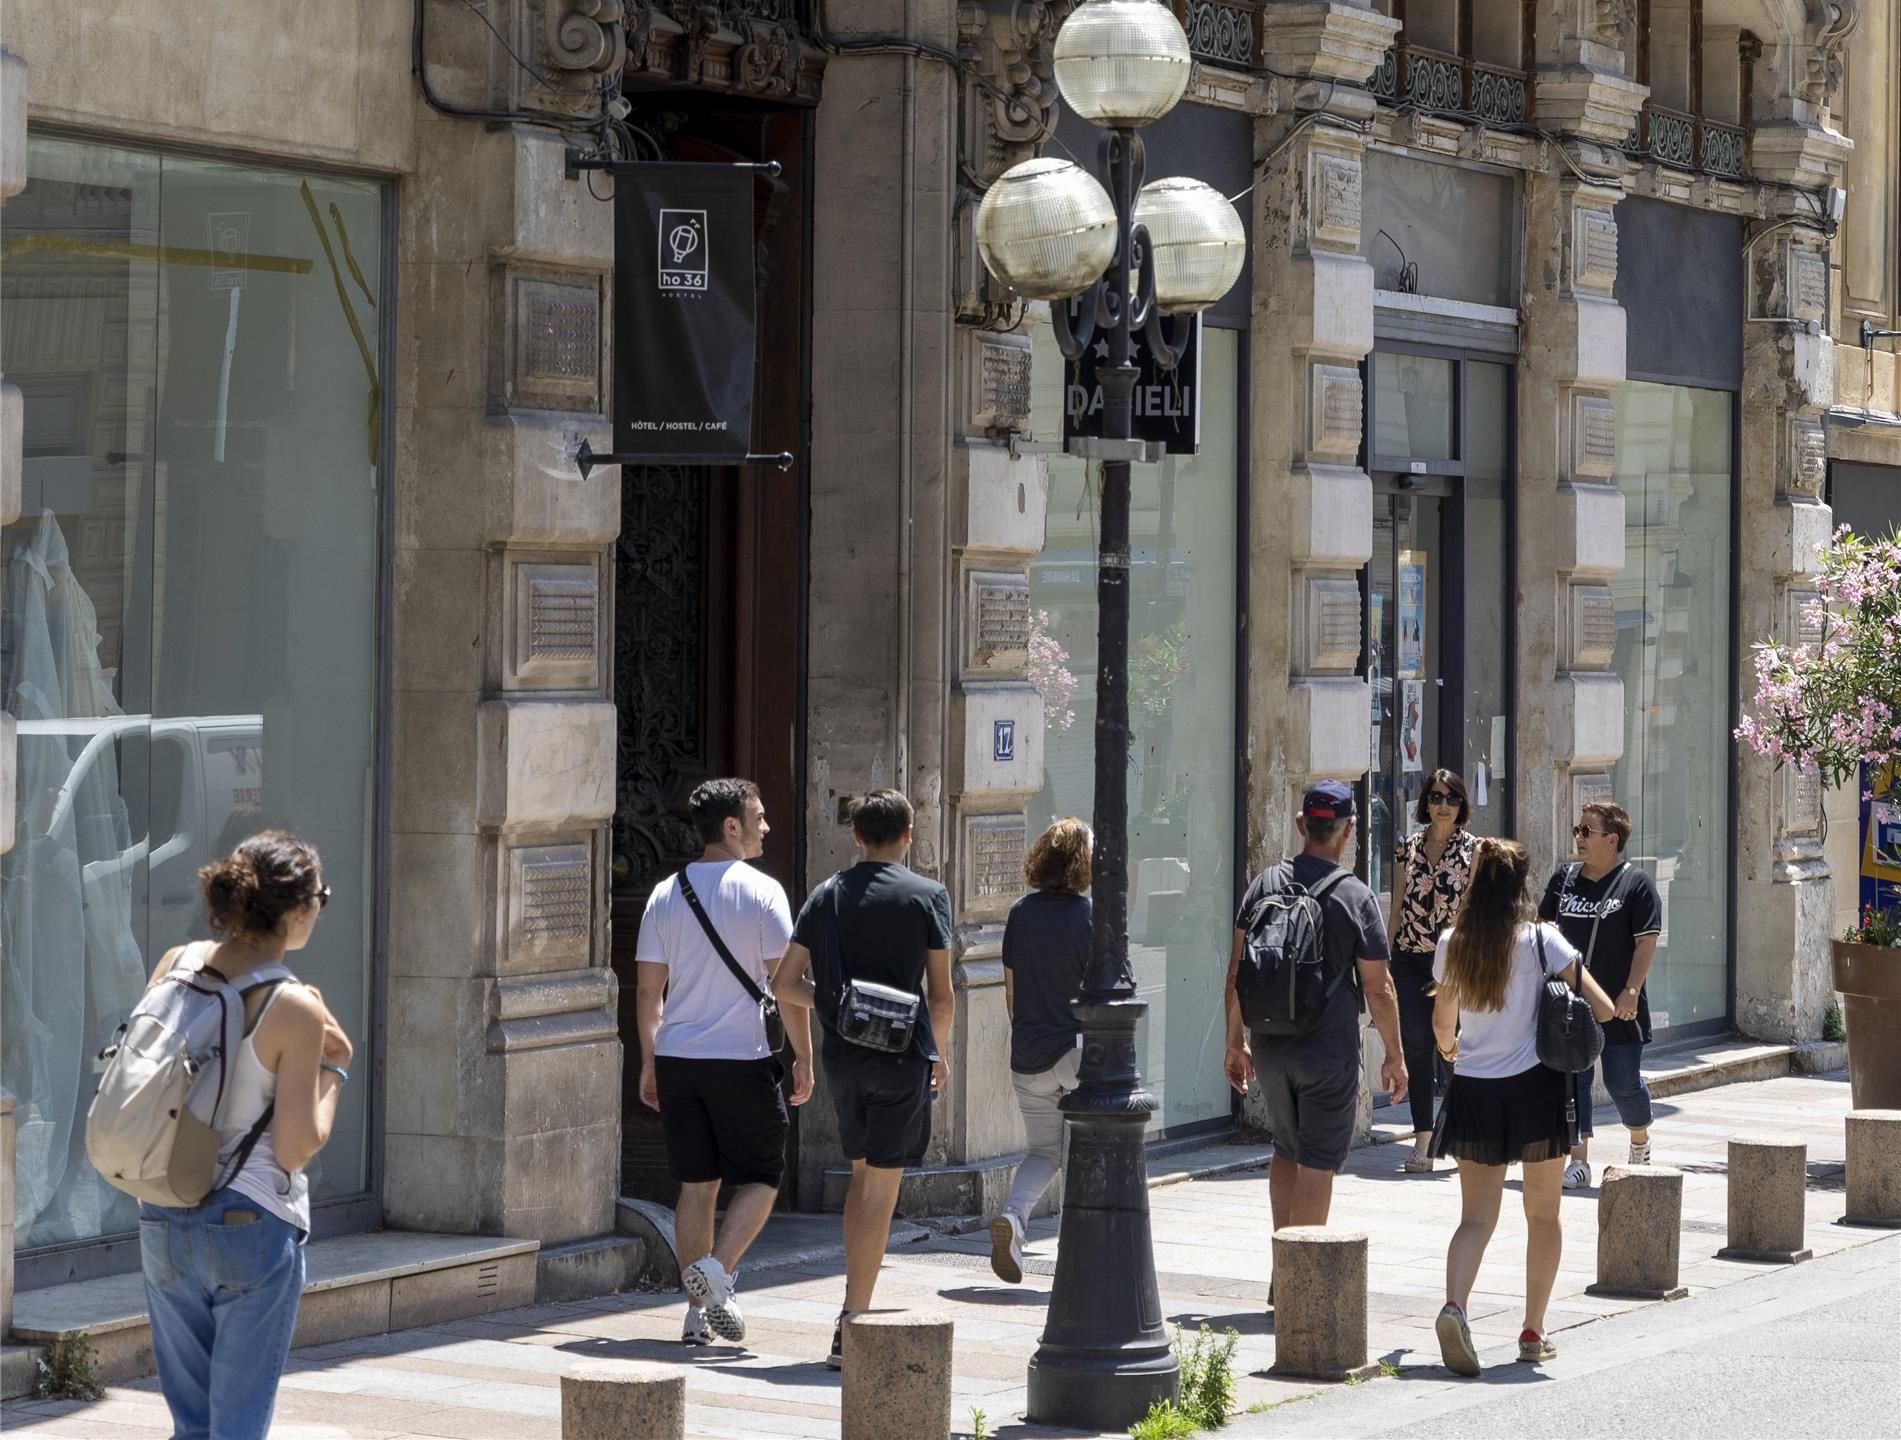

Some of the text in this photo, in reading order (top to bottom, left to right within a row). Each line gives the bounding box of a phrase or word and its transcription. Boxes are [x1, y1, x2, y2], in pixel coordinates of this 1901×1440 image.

[663, 273, 702, 286] ho 36
[1067, 385, 1190, 416] DAIELI
[631, 420, 658, 430] HÔTEL
[666, 422, 697, 430] HOSTEL
[705, 420, 728, 430] CAFÉ
